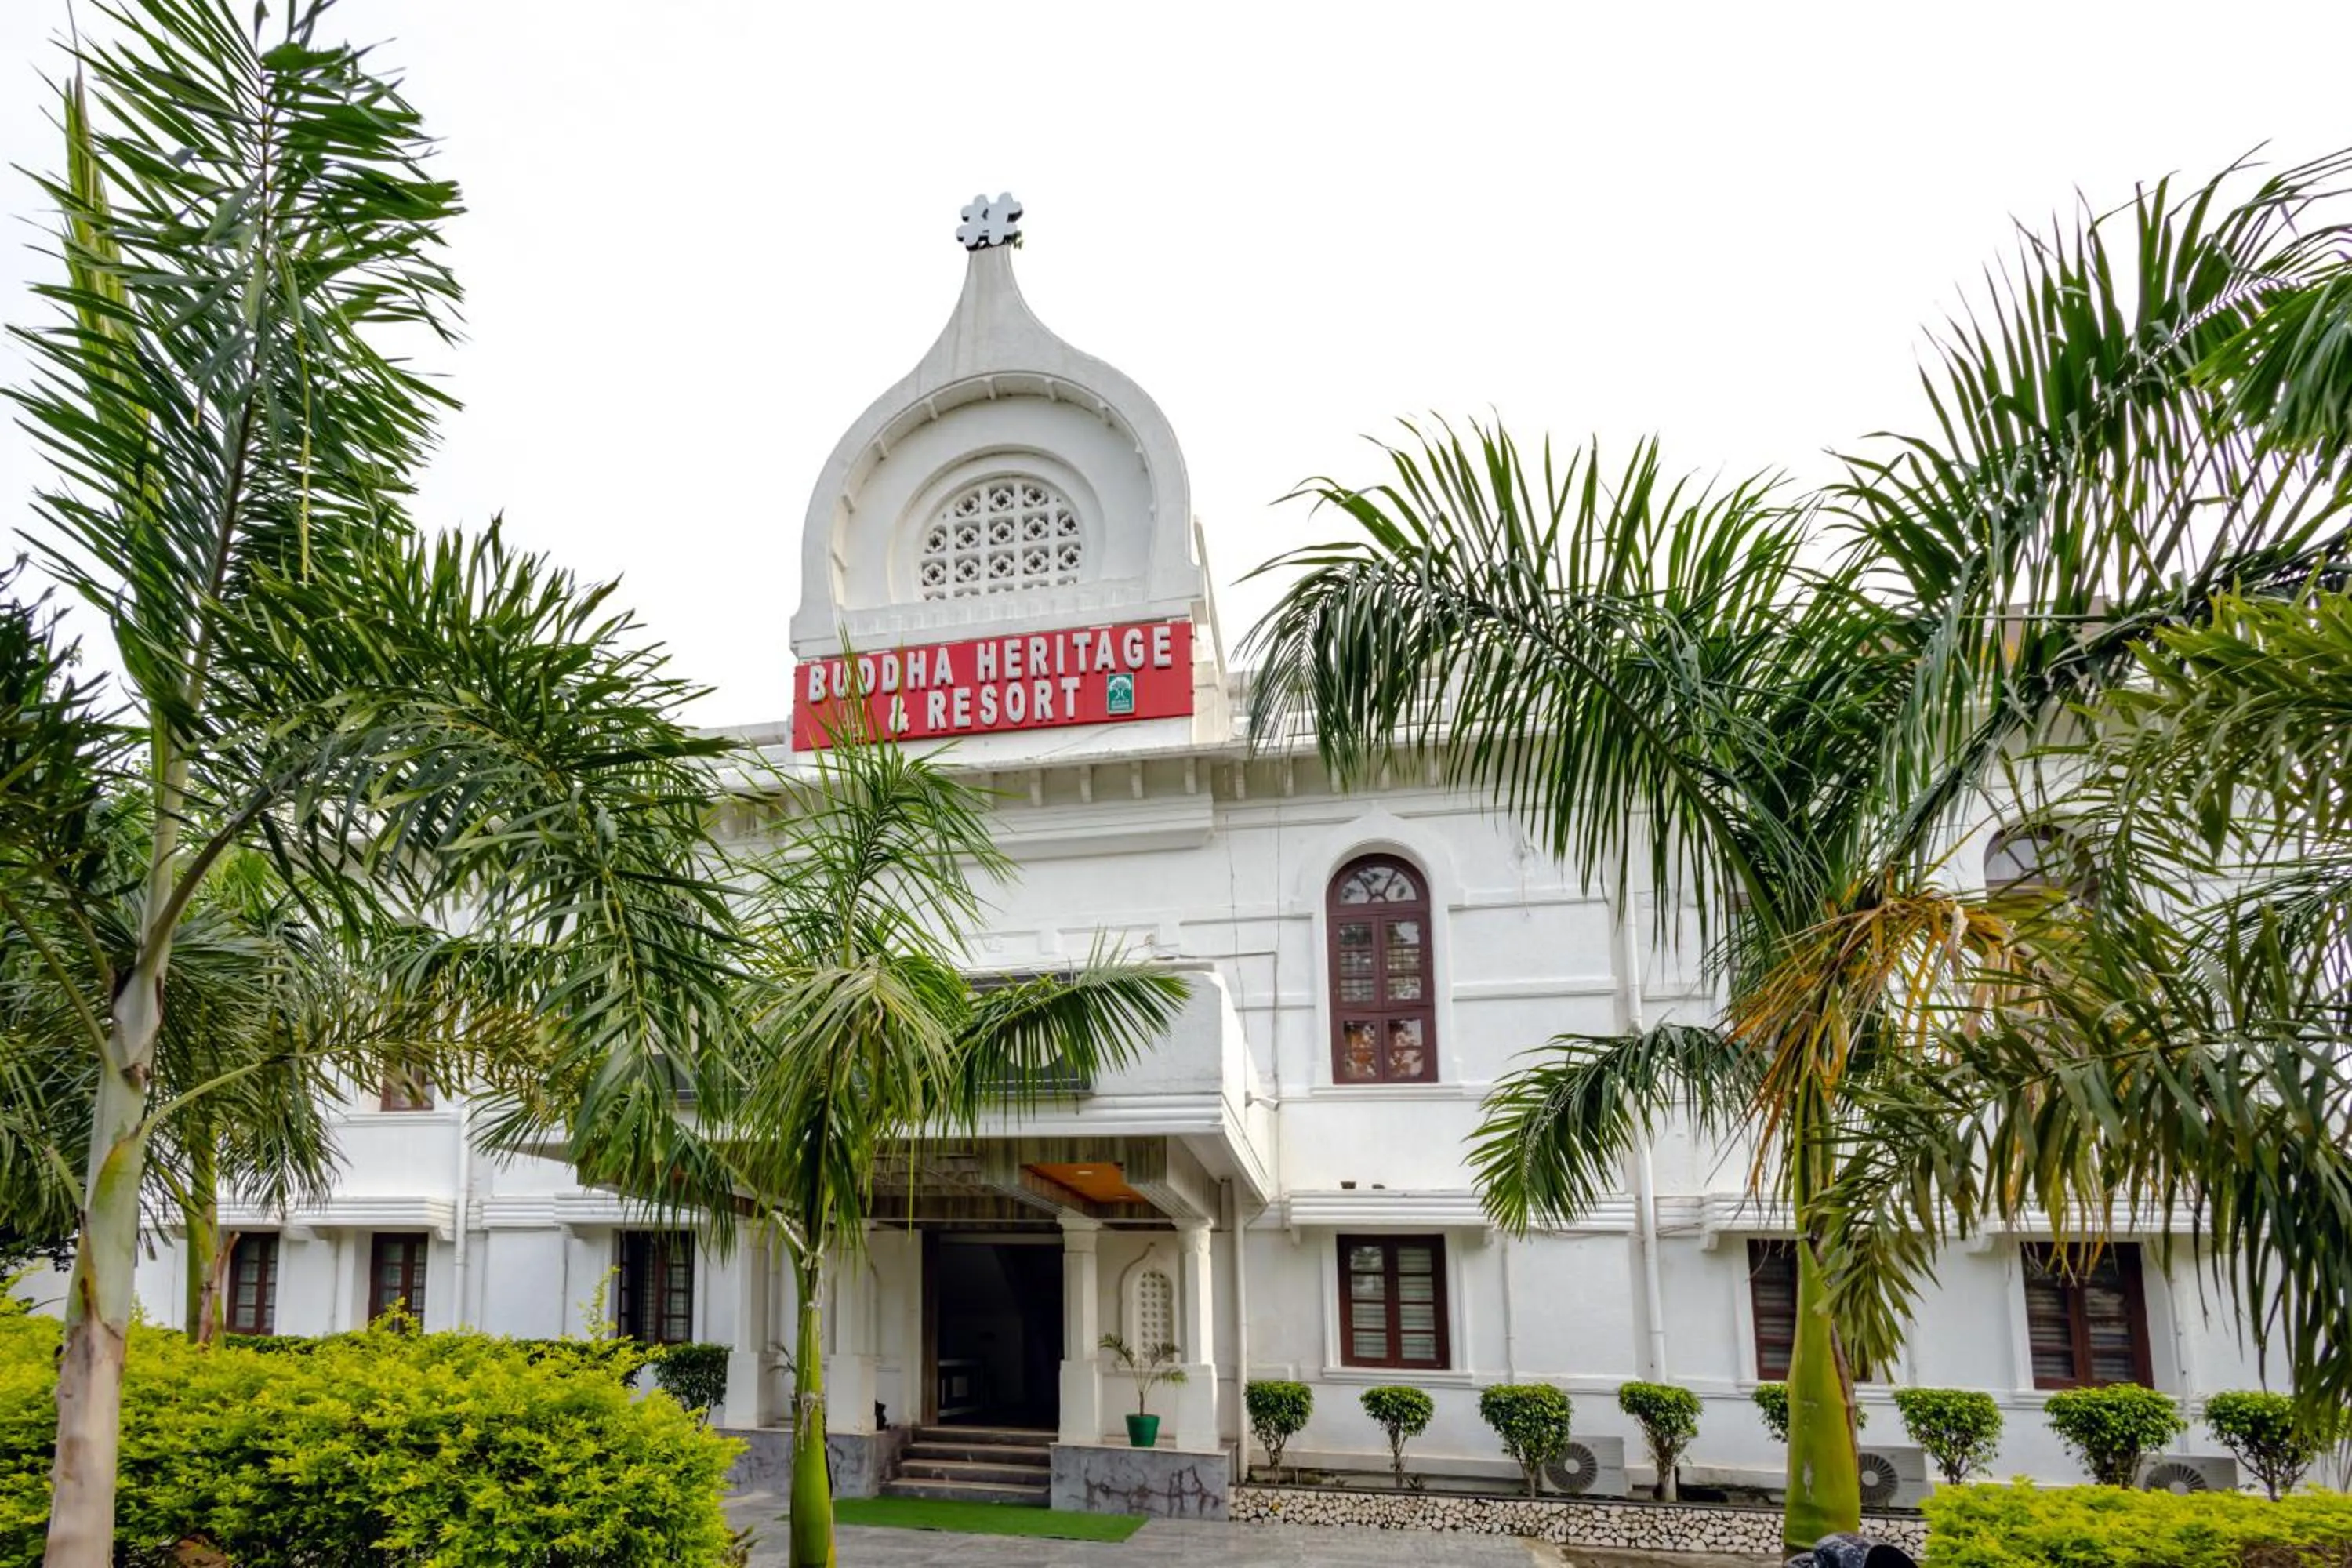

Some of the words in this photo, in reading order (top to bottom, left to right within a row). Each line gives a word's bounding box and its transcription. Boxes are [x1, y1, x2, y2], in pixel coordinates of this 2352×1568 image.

[808, 648, 954, 703] BUDDHA
[977, 626, 1173, 684] HERITAGE
[888, 695, 909, 734] &
[927, 677, 1080, 731] RESORT
